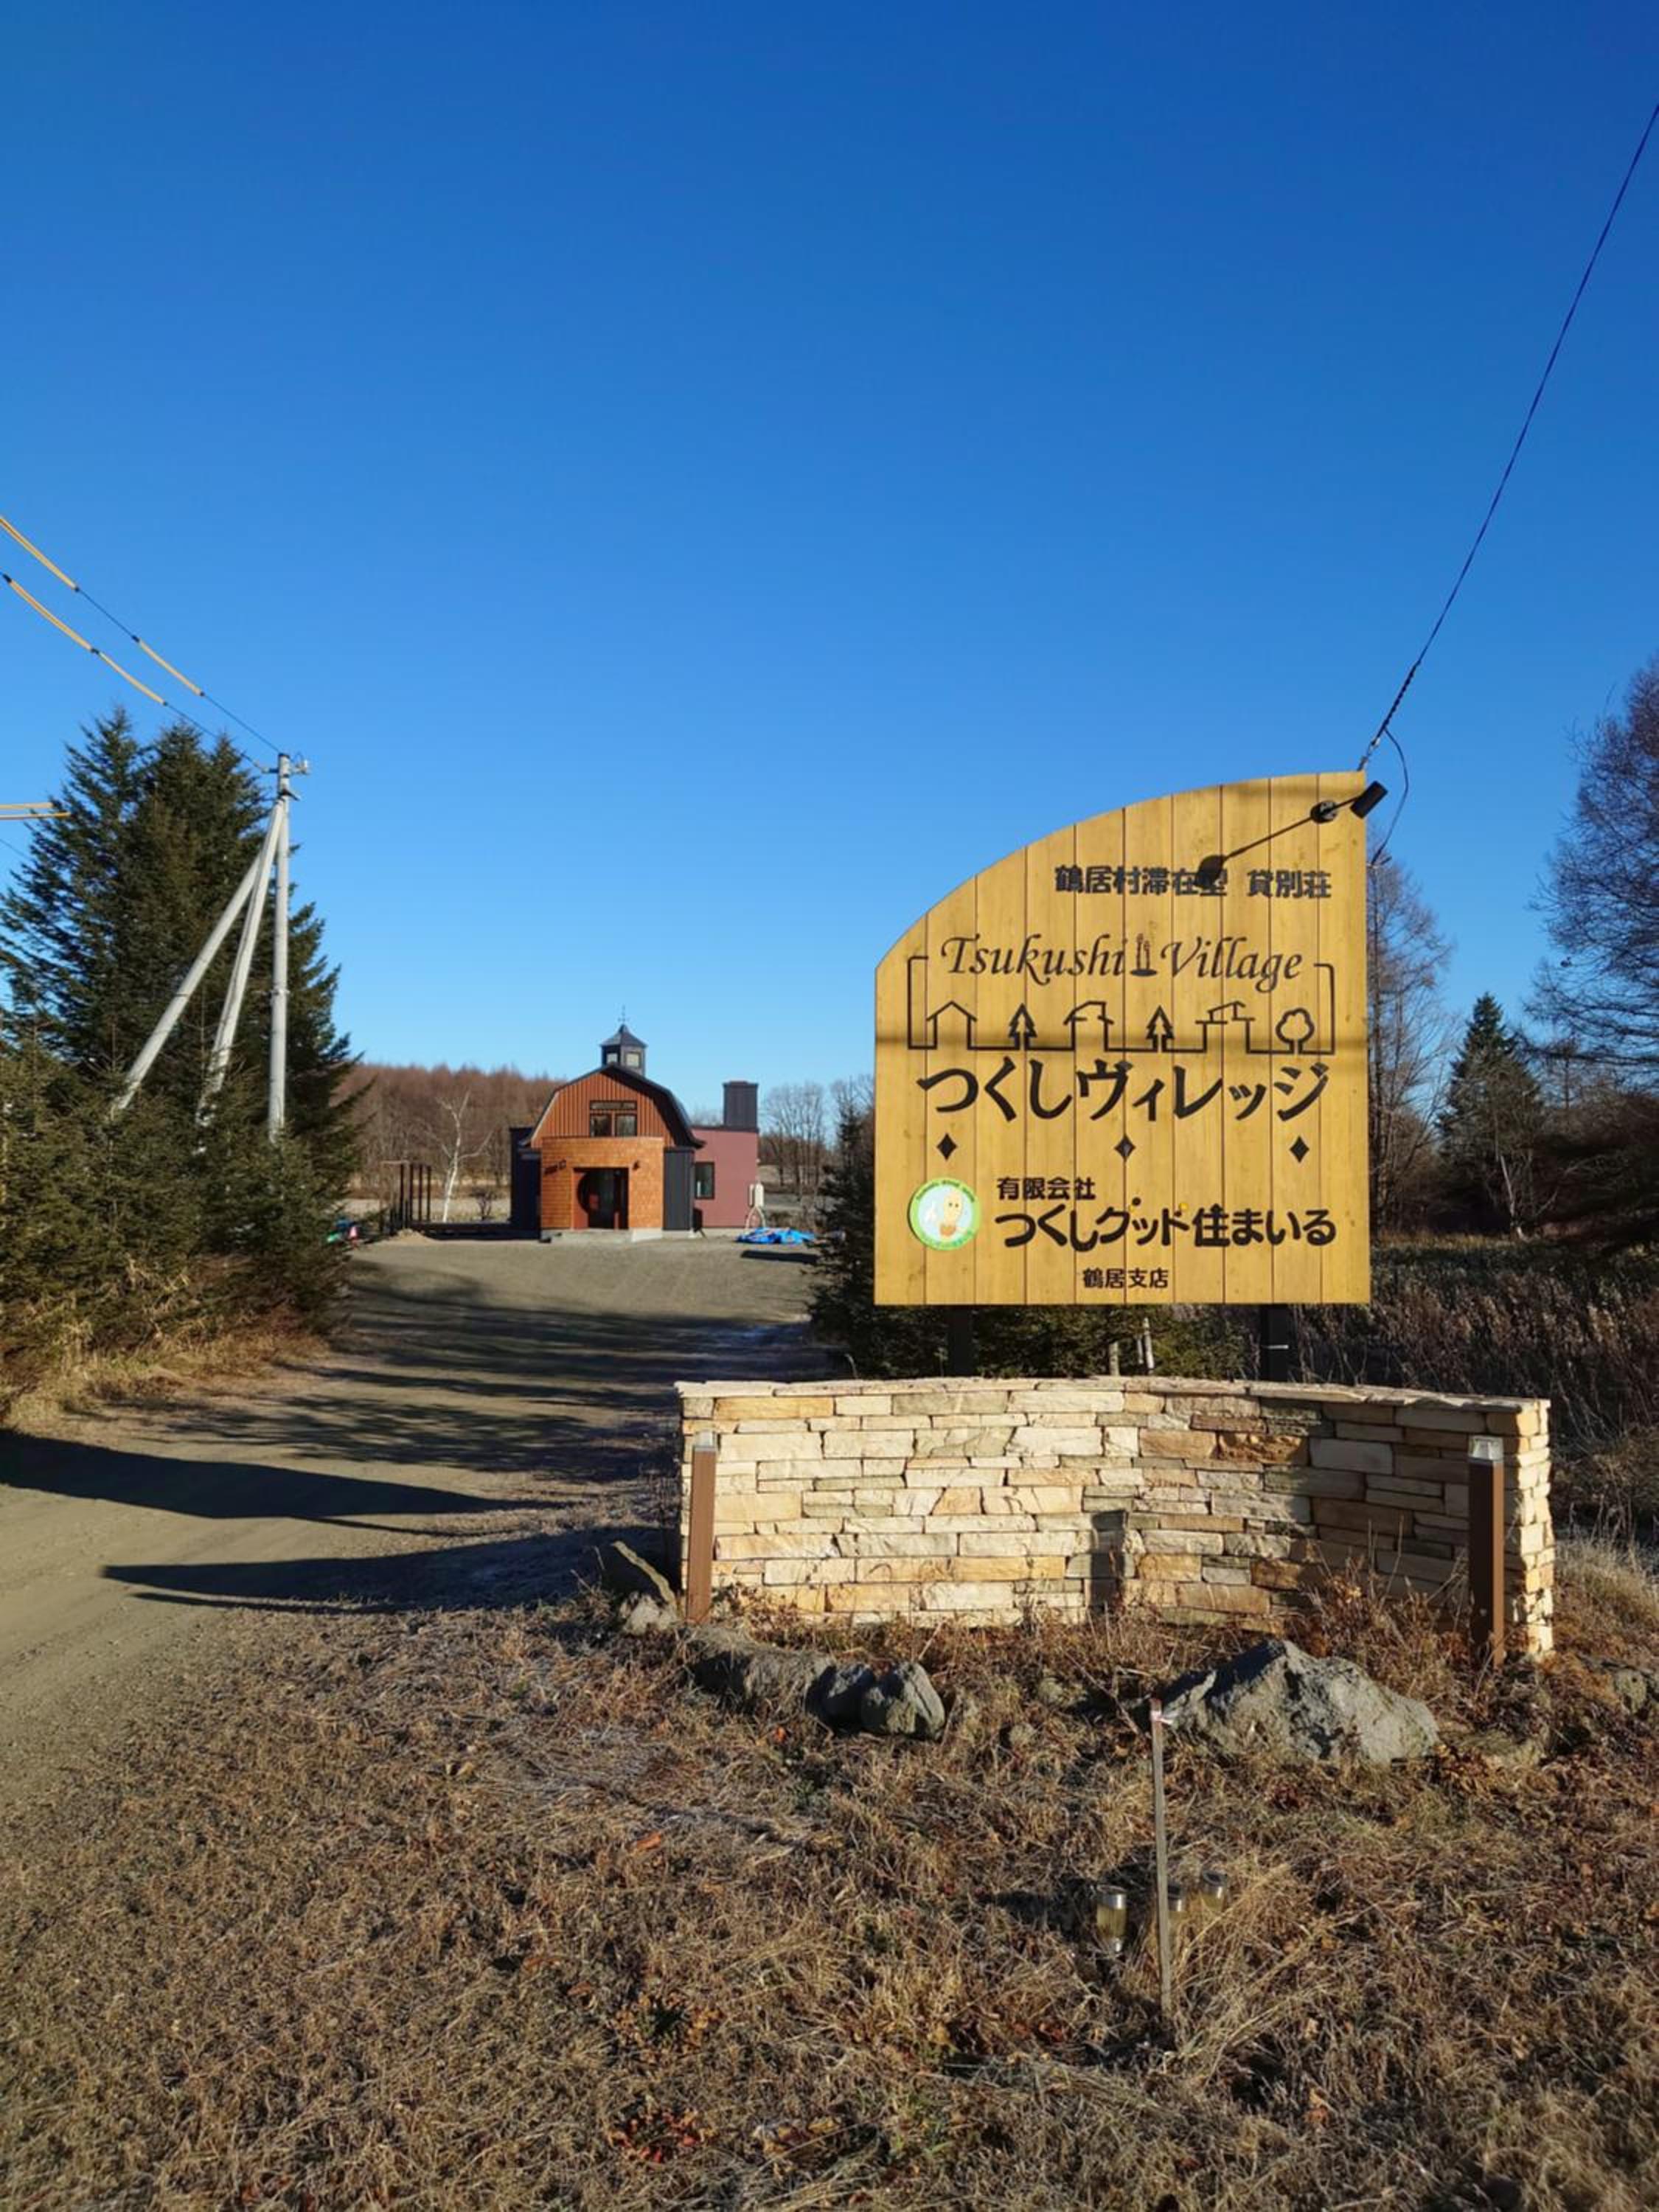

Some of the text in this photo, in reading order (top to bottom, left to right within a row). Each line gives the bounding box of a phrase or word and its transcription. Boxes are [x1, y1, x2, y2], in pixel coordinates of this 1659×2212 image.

[1247, 869, 1332, 897] 貸別荘
[940, 933, 1303, 992] Tsukushi Village
[916, 1056, 1329, 1122] つくしヴィレッジ
[996, 1177, 1096, 1200] 有限会社
[995, 1197, 1338, 1252] つくしグッド住まいる
[1082, 1267, 1169, 1289] 鶴居支店
